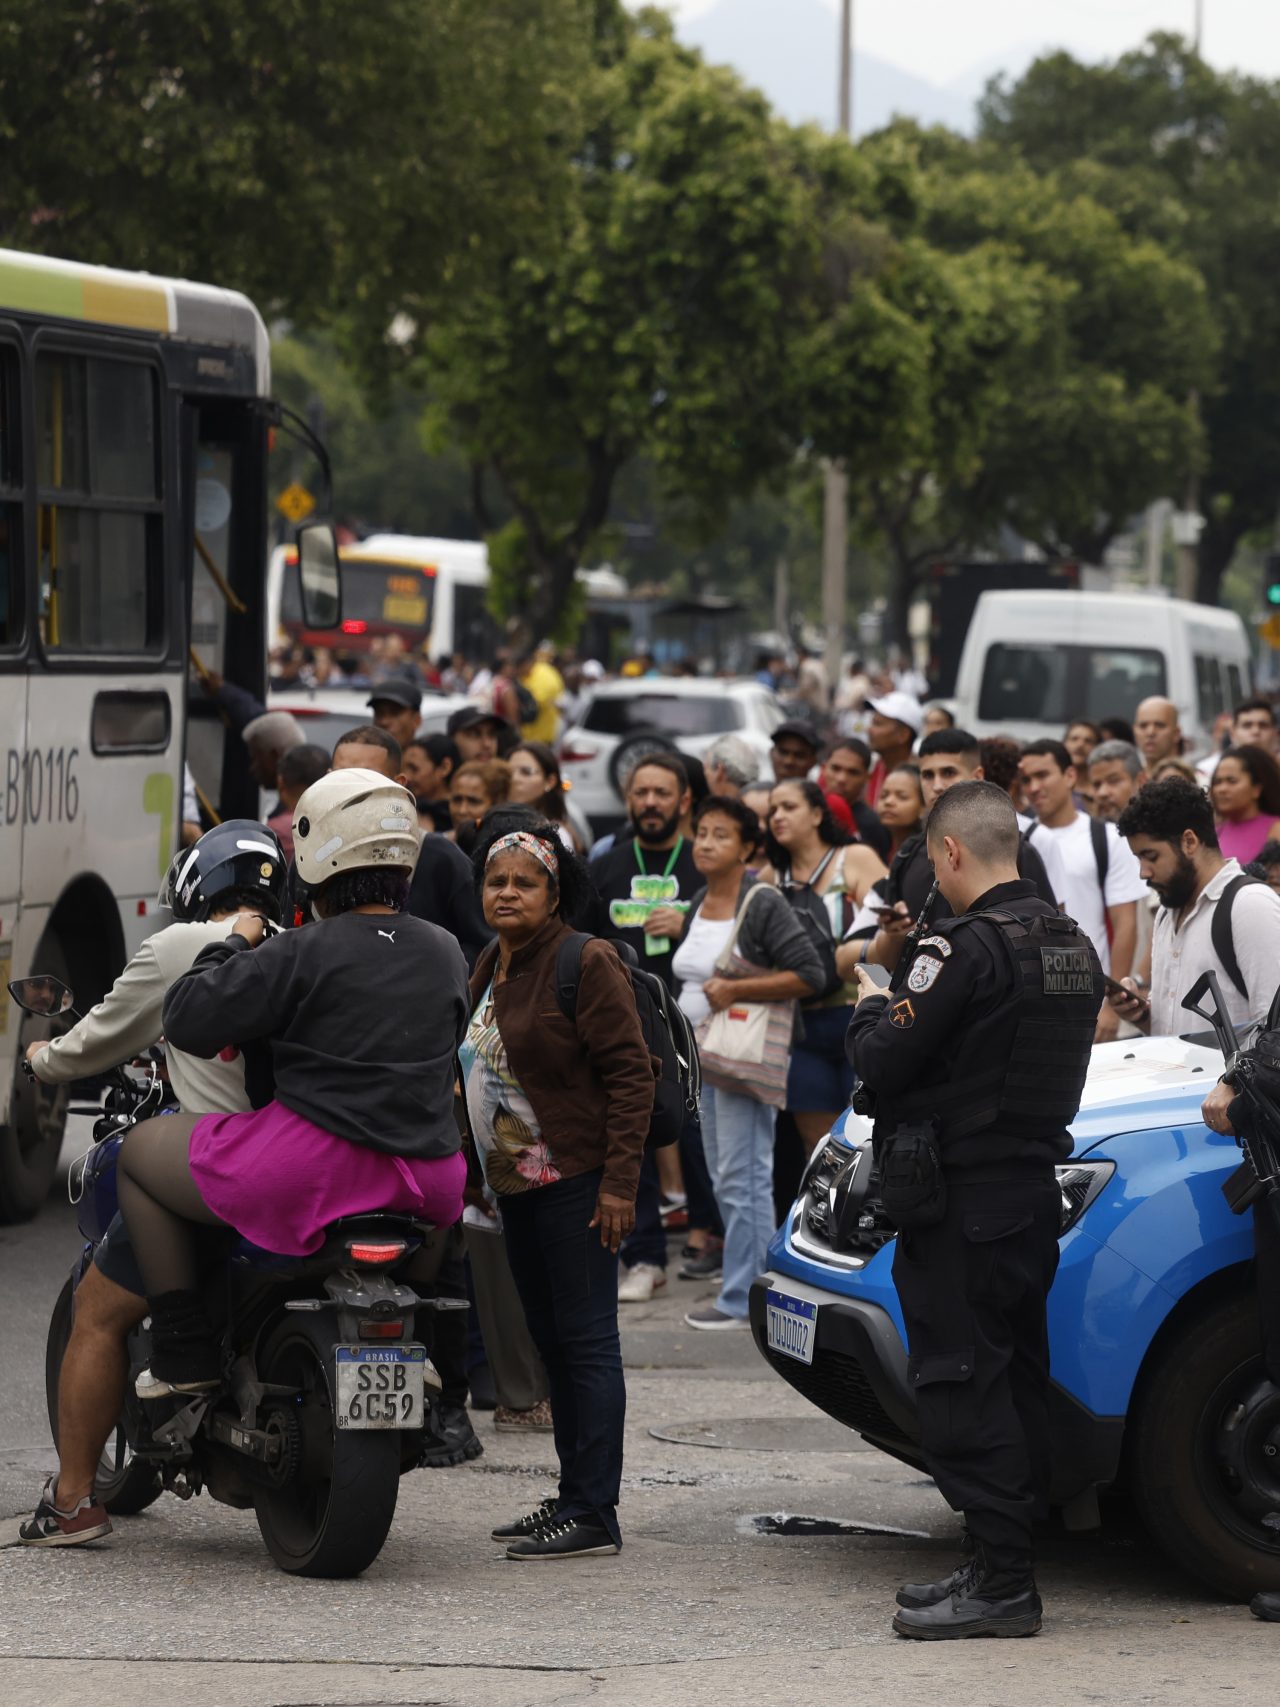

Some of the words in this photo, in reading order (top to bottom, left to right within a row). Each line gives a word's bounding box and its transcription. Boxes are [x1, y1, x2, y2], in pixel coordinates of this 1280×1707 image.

[6, 747, 80, 826] B10116
[1045, 974, 1091, 991] MILITAR
[365, 1353, 400, 1362] BRASIL
[357, 1364, 407, 1391] SSB
[348, 1393, 414, 1421] 6C59
[339, 1415, 349, 1426] BR
